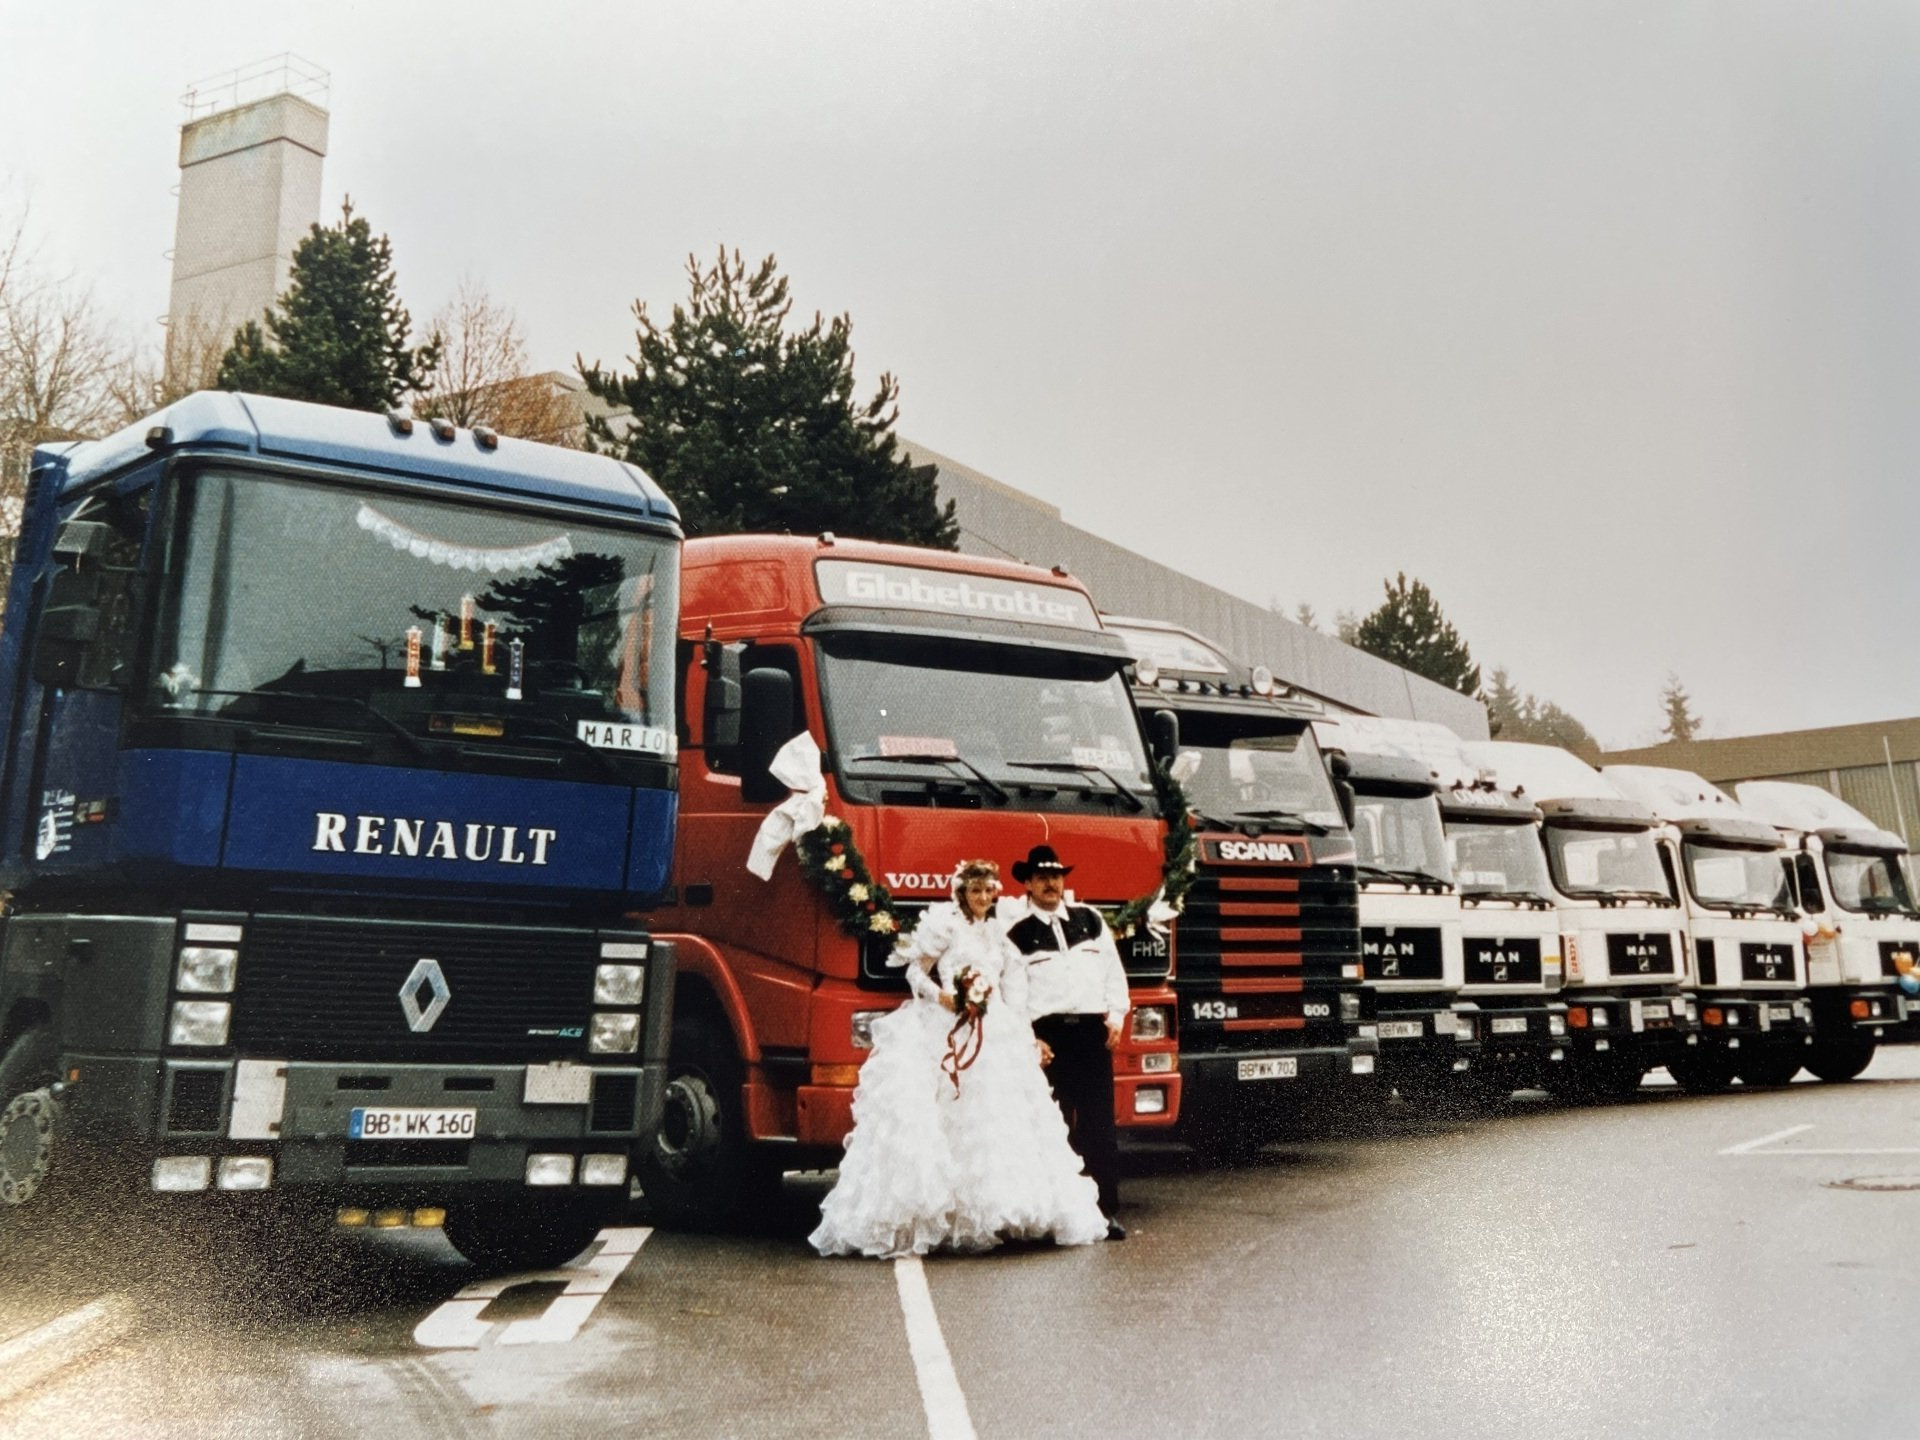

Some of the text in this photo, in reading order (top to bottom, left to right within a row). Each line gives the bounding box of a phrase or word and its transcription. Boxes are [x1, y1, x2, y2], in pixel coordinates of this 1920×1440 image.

[846, 571, 1079, 622] Globetrotter
[584, 725, 663, 750] MARIO
[312, 812, 557, 865] RENAULT
[1219, 841, 1294, 861] SCANIA
[884, 872, 953, 889] VOLV
[1132, 941, 1166, 957] FH12
[1363, 943, 1415, 955] MAN
[1479, 951, 1520, 963] MAN
[1626, 945, 1657, 956] MAN
[1756, 954, 1782, 964] MAN
[1303, 1004, 1330, 1016] 600
[1259, 1062, 1275, 1076] WK
[1277, 1061, 1296, 1075] 702
[364, 1114, 473, 1134] BB WK 160
